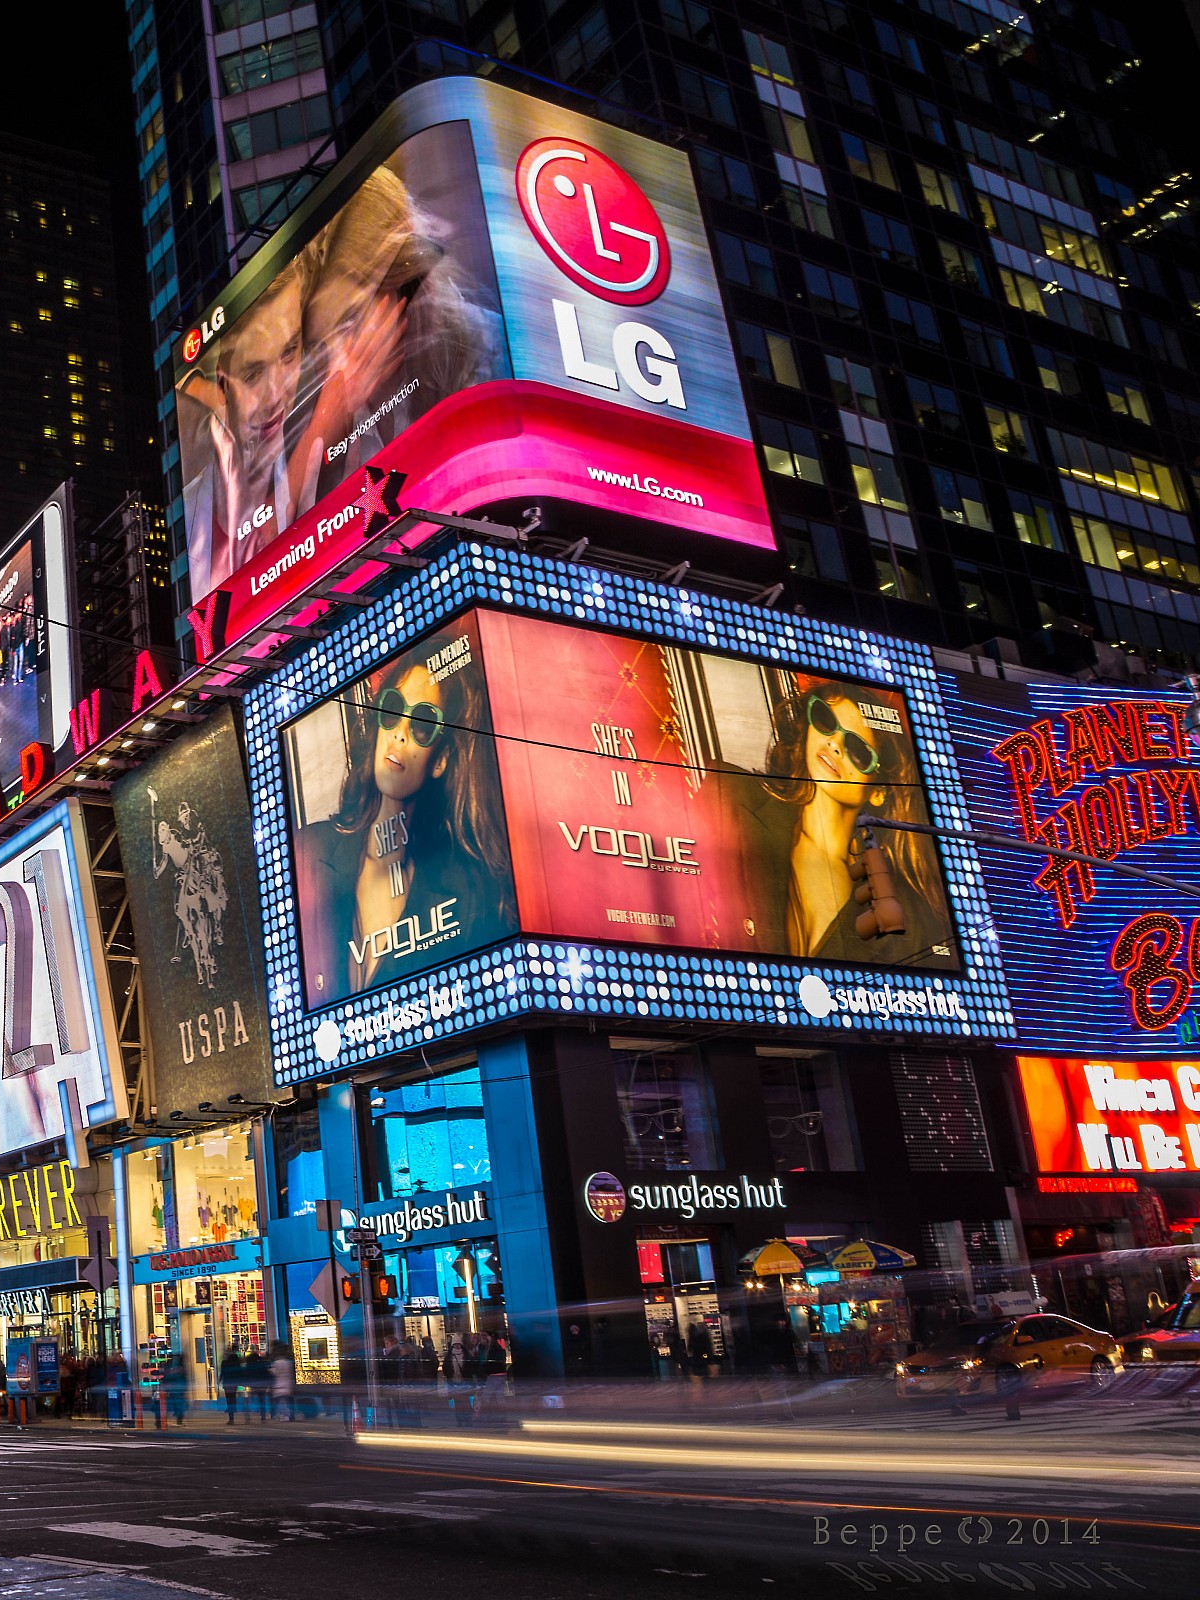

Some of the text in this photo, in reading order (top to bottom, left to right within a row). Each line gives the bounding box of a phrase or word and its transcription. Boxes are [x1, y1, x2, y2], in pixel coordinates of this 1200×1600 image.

[201, 306, 225, 344] LG
[551, 298, 688, 411] LG
[326, 437, 349, 462] Easy
[586, 465, 704, 508] www.LG.com
[237, 503, 274, 541] LG G2
[251, 534, 315, 597] Learning
[439, 634, 471, 666] MENDES
[590, 721, 637, 762] SHE'S
[611, 770, 632, 807] IN
[990, 701, 1193, 844] PLANET
[374, 811, 409, 859] SHE'S
[557, 821, 700, 869] VOGUE
[1035, 769, 1200, 930] HOLLY
[388, 860, 405, 899] IN
[649, 861, 702, 877] eyewear
[348, 897, 461, 966] VOGUE
[416, 926, 462, 953] eyewear
[177, 1000, 250, 1065] USPA
[360, 1190, 486, 1243] sunglass hut
[630, 1174, 740, 1219] sunglass
[742, 1174, 787, 1209] hut
[171, 1265, 217, 1278] SINCE 1890
[834, 1260, 875, 1270] SABRETT
[38, 1355, 56, 1363] HERE
